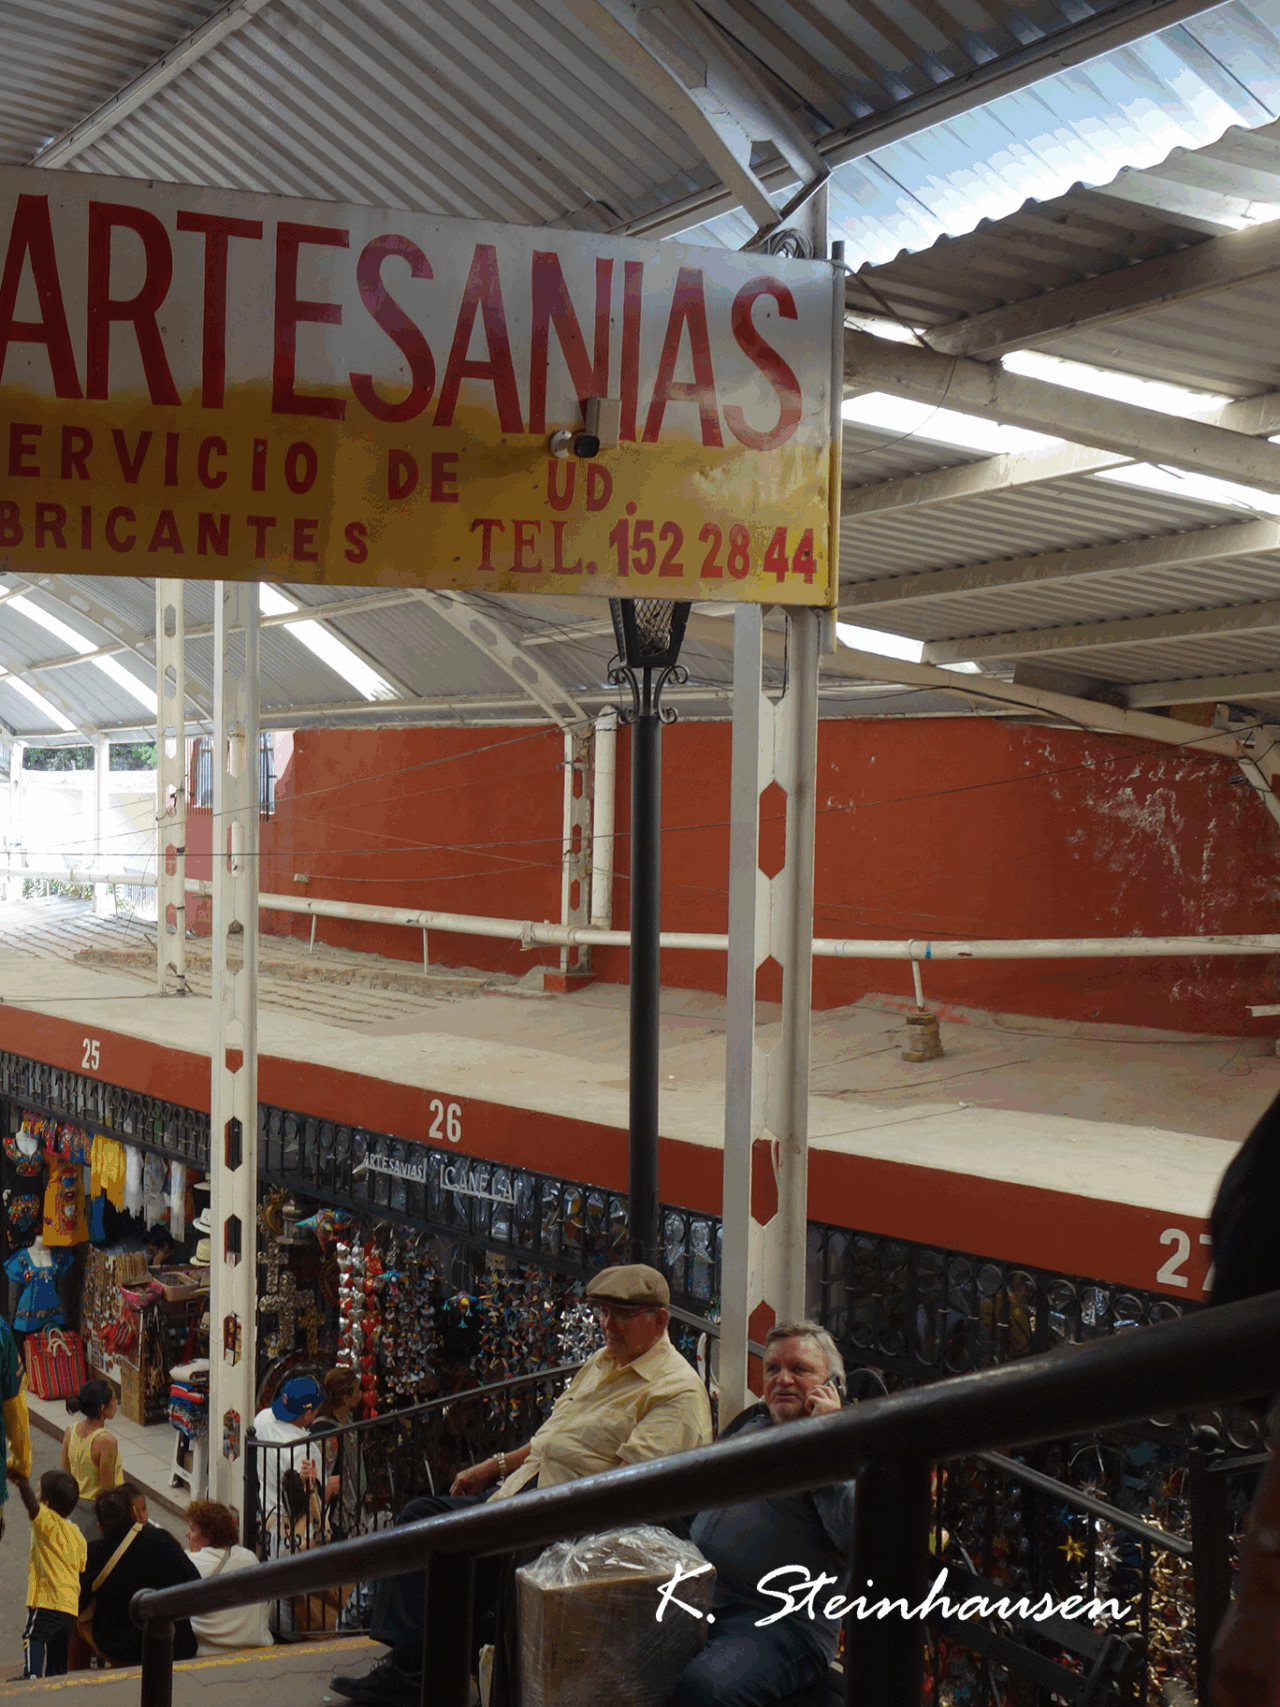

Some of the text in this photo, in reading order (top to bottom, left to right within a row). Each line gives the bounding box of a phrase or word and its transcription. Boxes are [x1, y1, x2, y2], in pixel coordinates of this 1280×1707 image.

[387, 448, 460, 503] DE
[470, 517, 599, 577] TEL.
[608, 518, 685, 578] 152
[698, 521, 752, 581] 28
[762, 525, 819, 585] 44
[81, 1037, 101, 1071] 25
[428, 1098, 462, 1143] 26
[444, 1165, 514, 1201] CANELA
